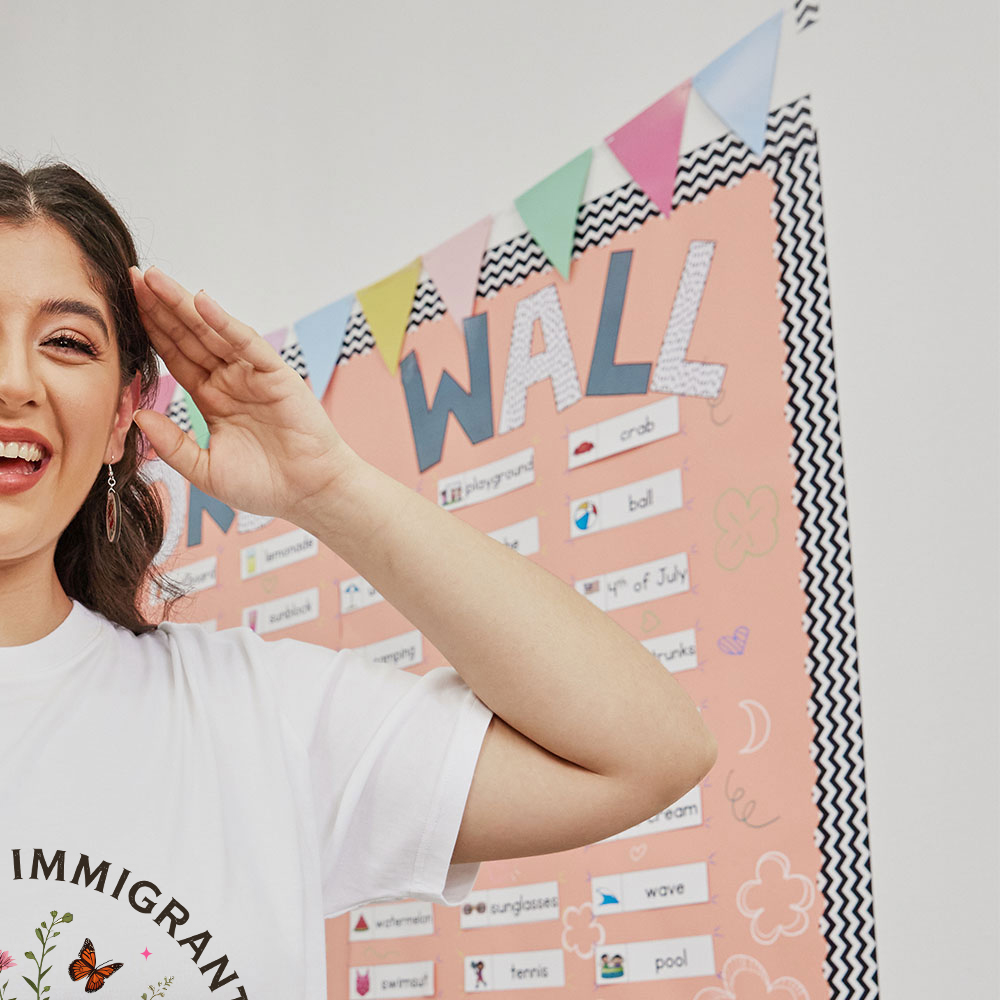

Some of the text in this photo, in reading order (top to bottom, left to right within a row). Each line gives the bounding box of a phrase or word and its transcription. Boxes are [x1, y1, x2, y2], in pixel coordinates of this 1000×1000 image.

[399, 240, 728, 474] WALL
[620, 417, 655, 441] crab
[629, 490, 654, 512] ball
[633, 572, 650, 590] of
[656, 564, 688, 586] July
[645, 882, 685, 899] wave
[491, 896, 558, 917] sunglasses
[511, 964, 548, 980] tennis
[655, 948, 688, 974] pool
